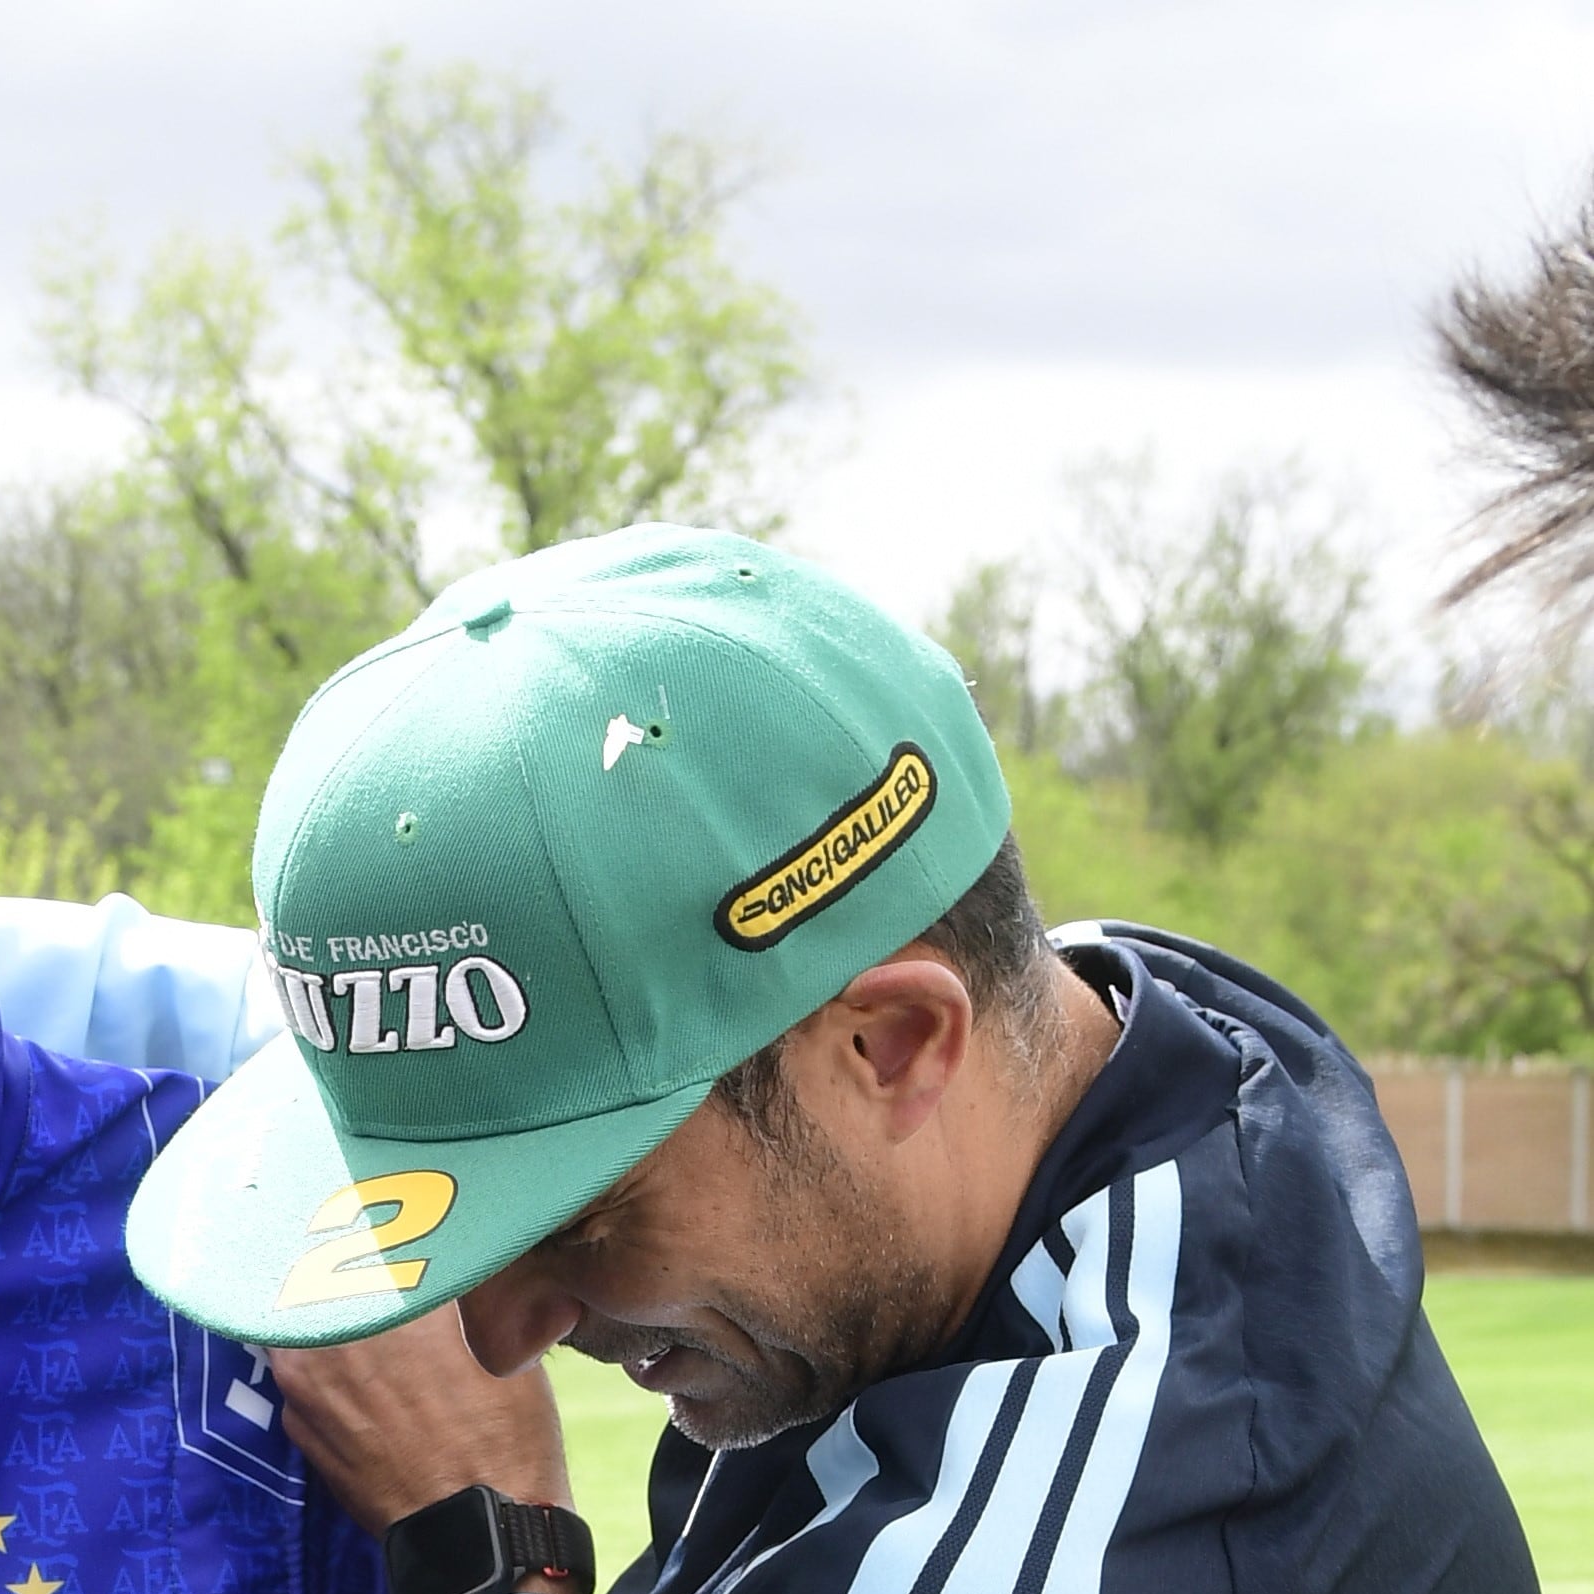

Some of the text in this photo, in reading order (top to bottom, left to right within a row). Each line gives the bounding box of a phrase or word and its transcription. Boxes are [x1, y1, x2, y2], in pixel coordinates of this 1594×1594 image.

[277, 921, 488, 962] DE FRANCISCO
[266, 953, 527, 1054] UZZO
[272, 1169, 459, 1312] 2
[8, 1340, 85, 1400] AFA
